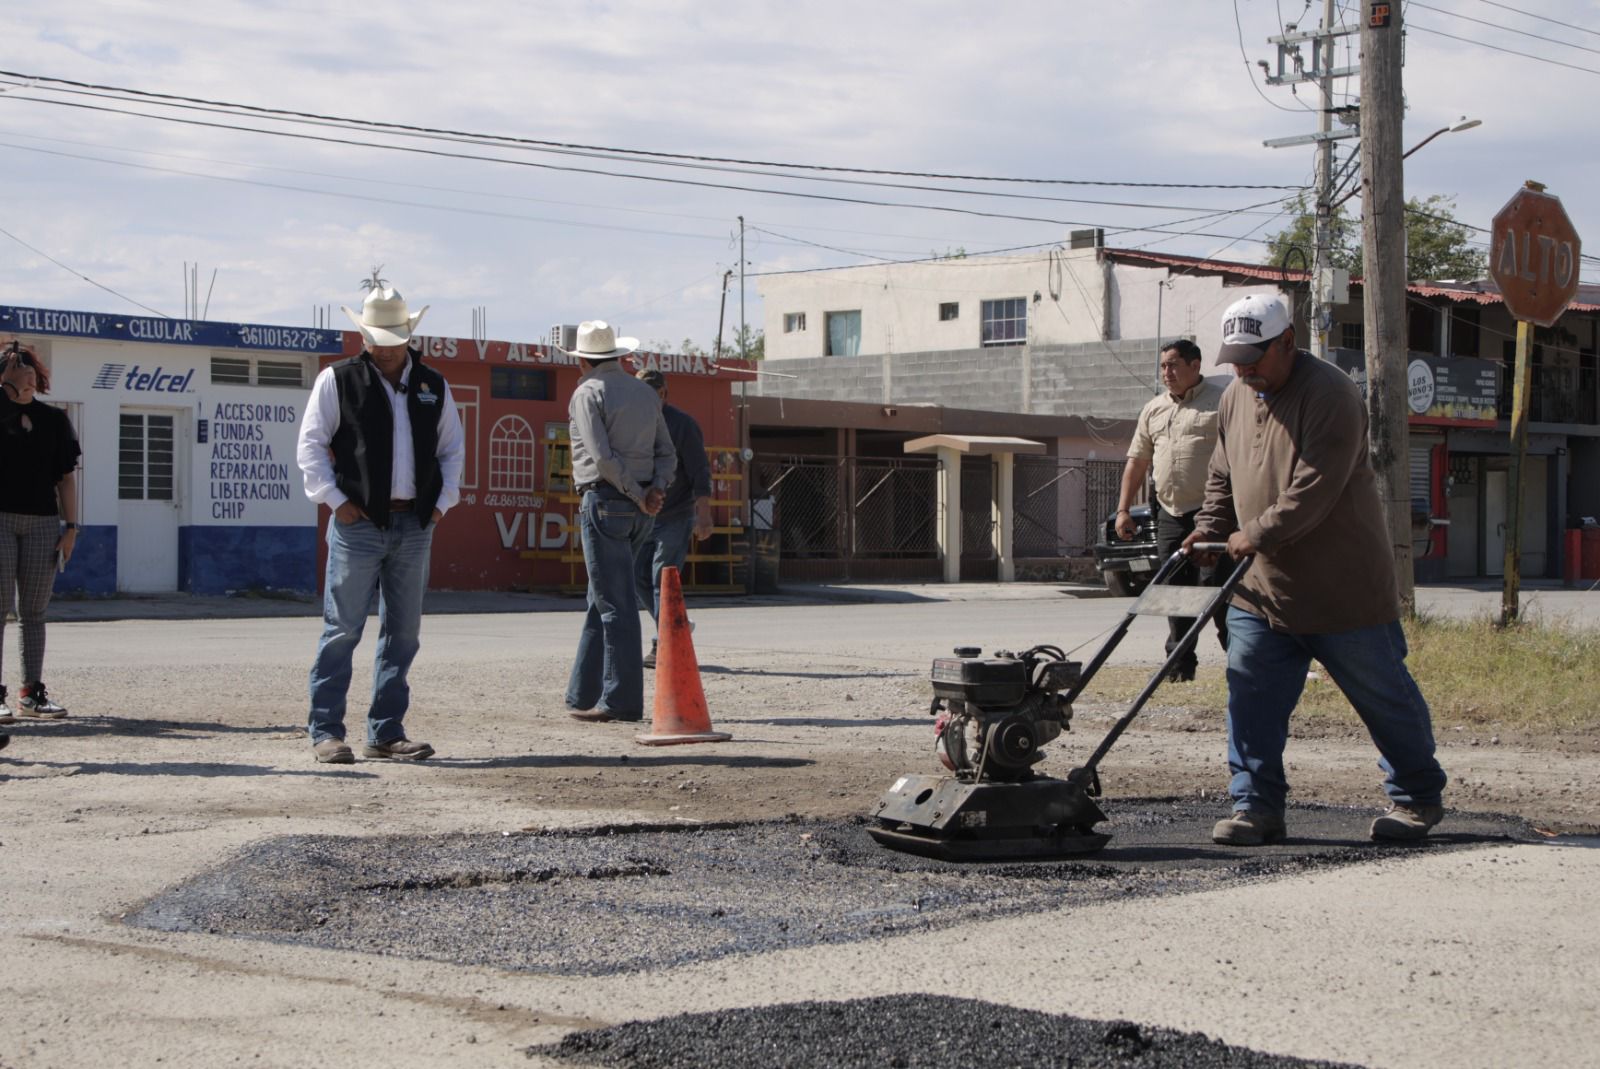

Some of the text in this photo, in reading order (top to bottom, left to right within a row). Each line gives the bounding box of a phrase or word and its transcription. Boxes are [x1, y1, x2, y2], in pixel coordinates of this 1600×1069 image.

[1498, 228, 1573, 289] ALTO
[16, 309, 99, 335] TELEFONIA
[129, 319, 193, 341] CELULAR
[1238, 316, 1263, 338] YORK
[475, 339, 489, 361] Y
[506, 342, 579, 366] ALUMI
[631, 351, 718, 376] SABINAS
[125, 365, 195, 393] telcel
[1413, 375, 1426, 387] LOS
[214, 402, 296, 423] ACCESORIOS
[213, 422, 264, 441] FUNDAS
[212, 442, 273, 461] ACESORIA
[210, 462, 288, 481] REPARACION
[210, 481, 290, 500] LIBERACION
[212, 501, 245, 519] CHIP
